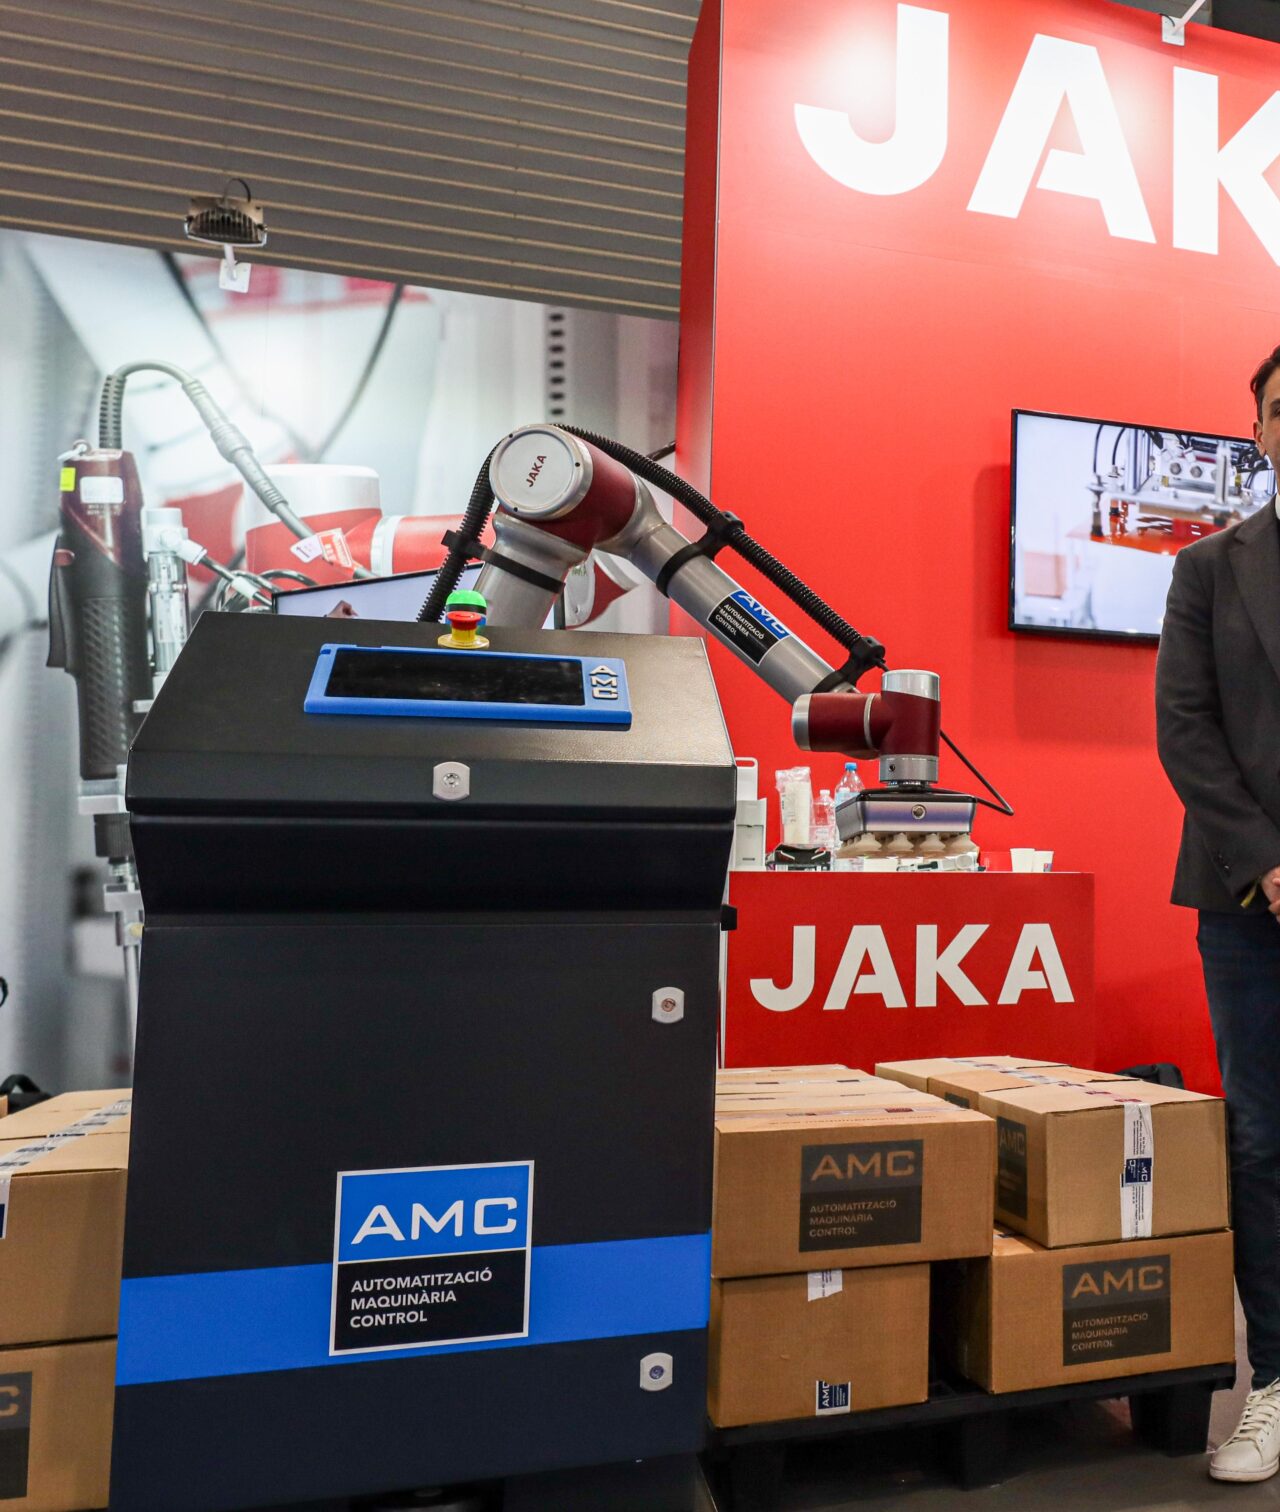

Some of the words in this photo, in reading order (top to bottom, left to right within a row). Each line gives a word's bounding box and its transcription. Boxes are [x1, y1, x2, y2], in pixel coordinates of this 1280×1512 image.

[526, 455, 547, 487] JAKA
[715, 614, 738, 637] CONTROL
[589, 664, 619, 700] AMC
[750, 924, 1075, 1012] JAKA
[811, 1150, 915, 1181] AMC
[351, 1197, 517, 1245] AMC
[809, 1227, 858, 1237] CONTROL
[351, 1267, 493, 1293] AUTOMATITZACIÓ
[1071, 1265, 1164, 1298] AMC
[351, 1290, 457, 1310] MAQUINÀRIA
[350, 1310, 428, 1328] CONTROL
[1072, 1340, 1113, 1352] CONTROL
